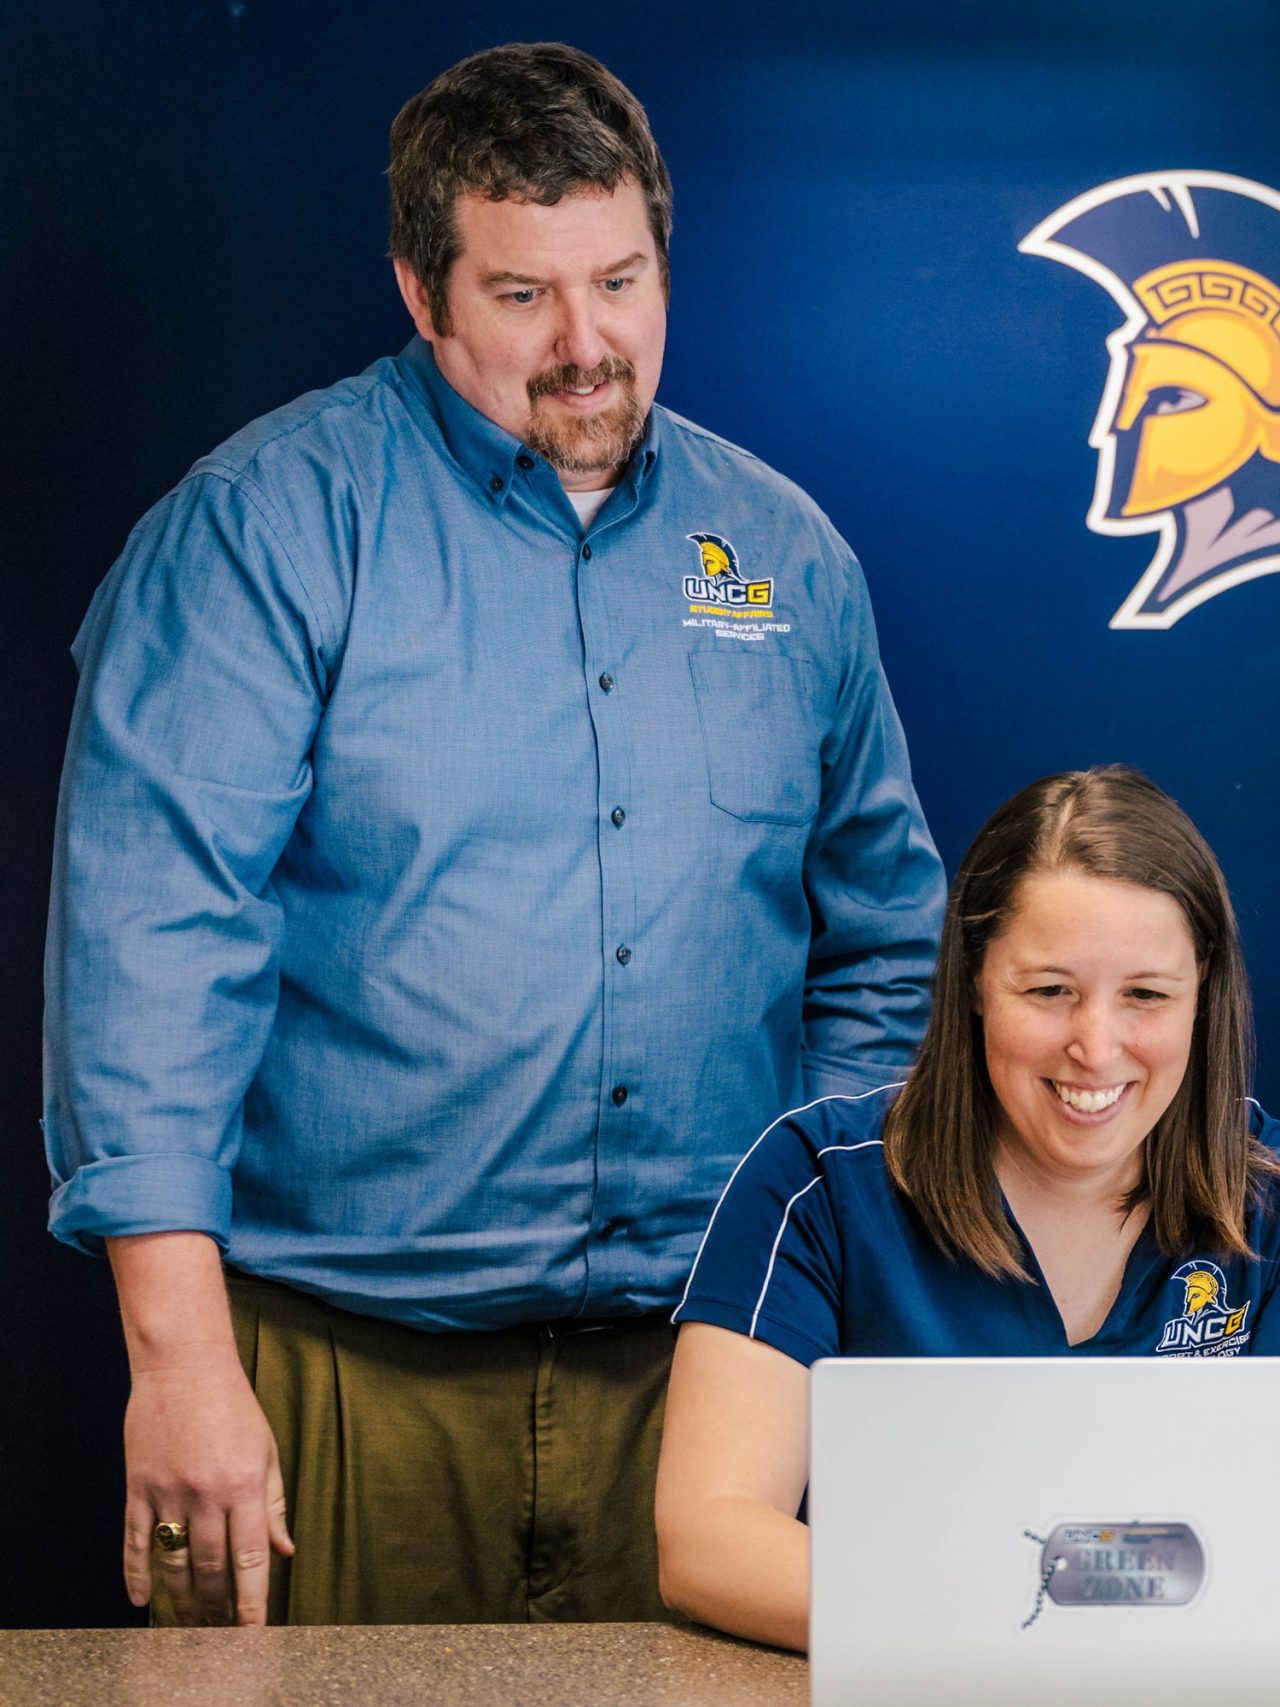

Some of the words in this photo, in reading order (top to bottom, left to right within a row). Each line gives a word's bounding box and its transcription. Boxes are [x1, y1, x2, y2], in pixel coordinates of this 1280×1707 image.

[684, 576, 773, 607] UNCG
[683, 618, 791, 633] MILITARY-AFFILIATED
[1158, 1306, 1248, 1350] UNCG
[1071, 1550, 1176, 1571] GREEN
[1084, 1576, 1166, 1599] ZONE
